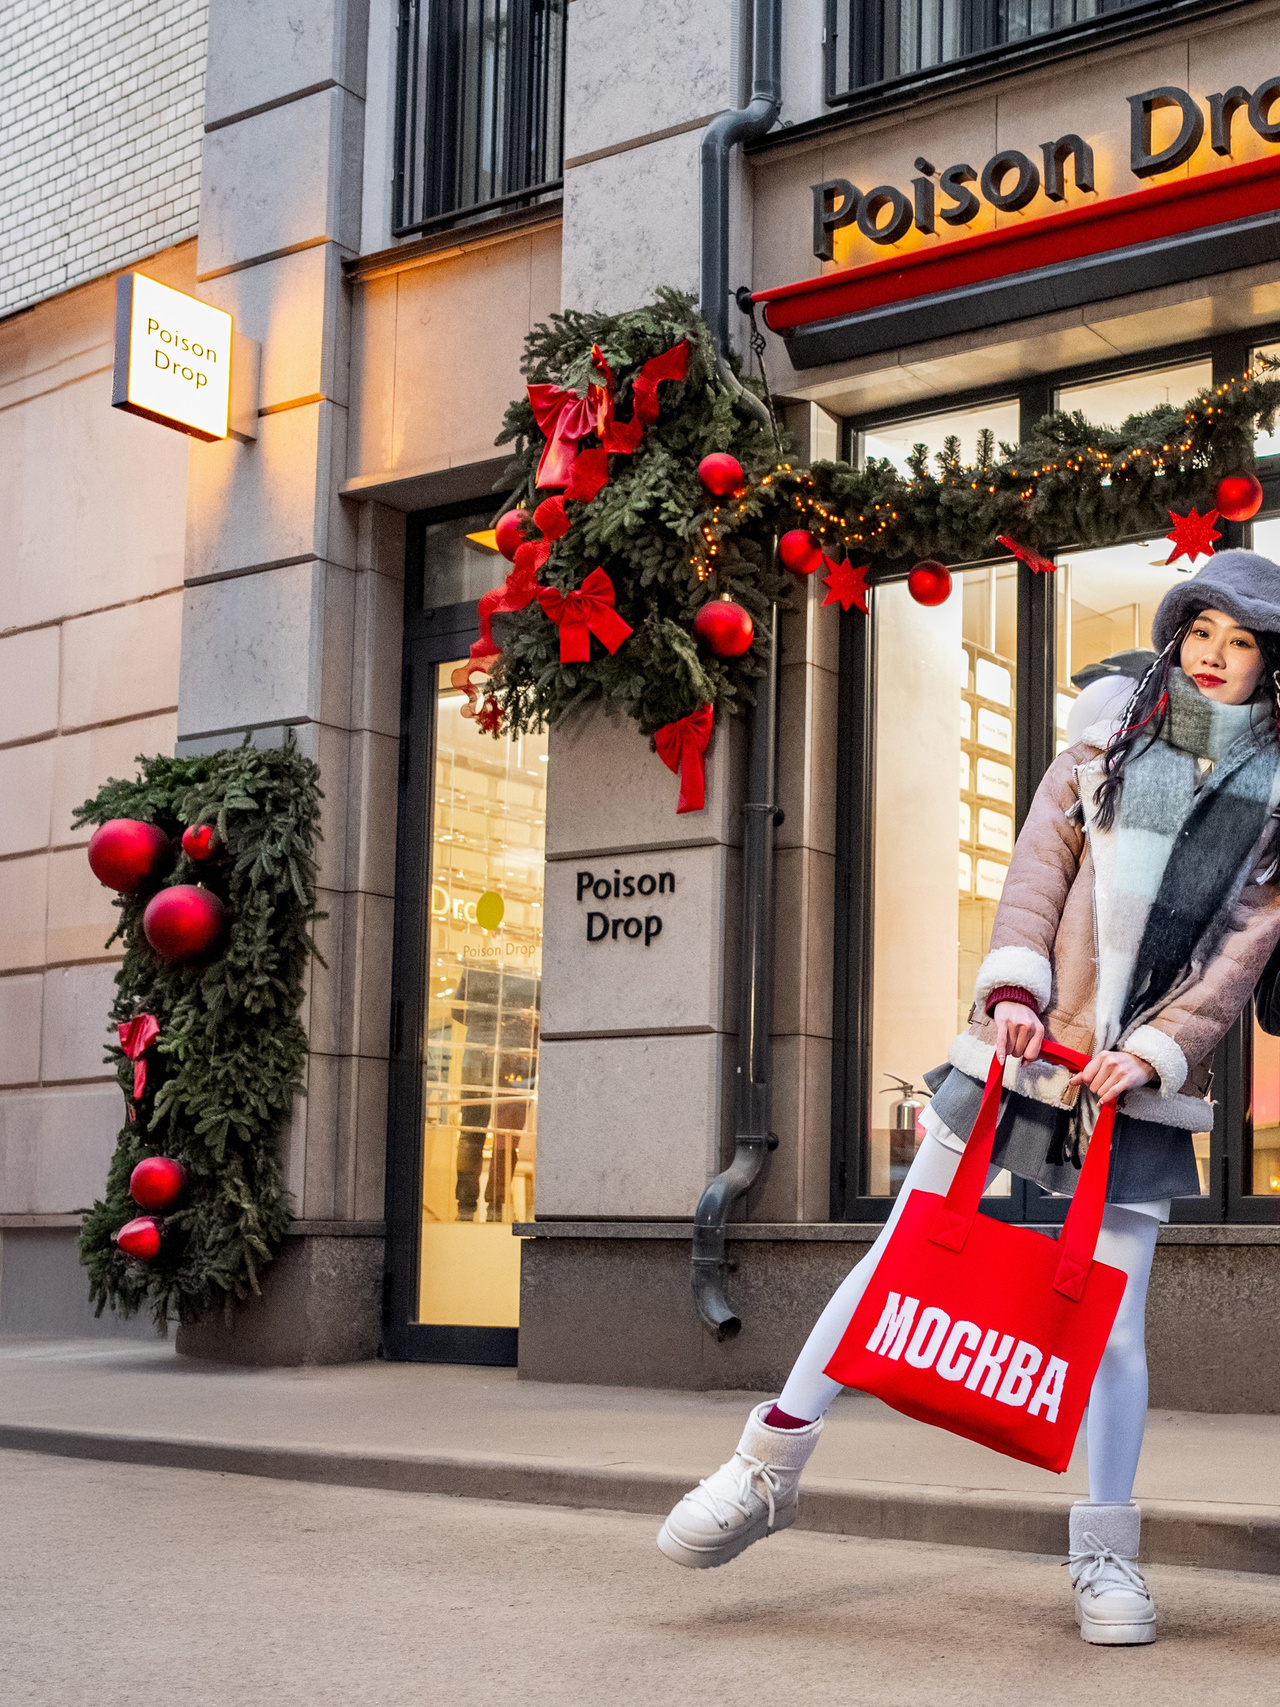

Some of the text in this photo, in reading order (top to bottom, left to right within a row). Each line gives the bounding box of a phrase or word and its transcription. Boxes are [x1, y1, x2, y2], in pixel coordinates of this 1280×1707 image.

[811, 132, 1096, 262] Poison
[147, 318, 217, 363] Poison
[155, 349, 208, 389] Drop
[576, 868, 676, 902] Poison
[586, 911, 663, 947] Drop
[463, 942, 536, 957] Poison Drop
[865, 1291, 1069, 1423] МОСКВА
